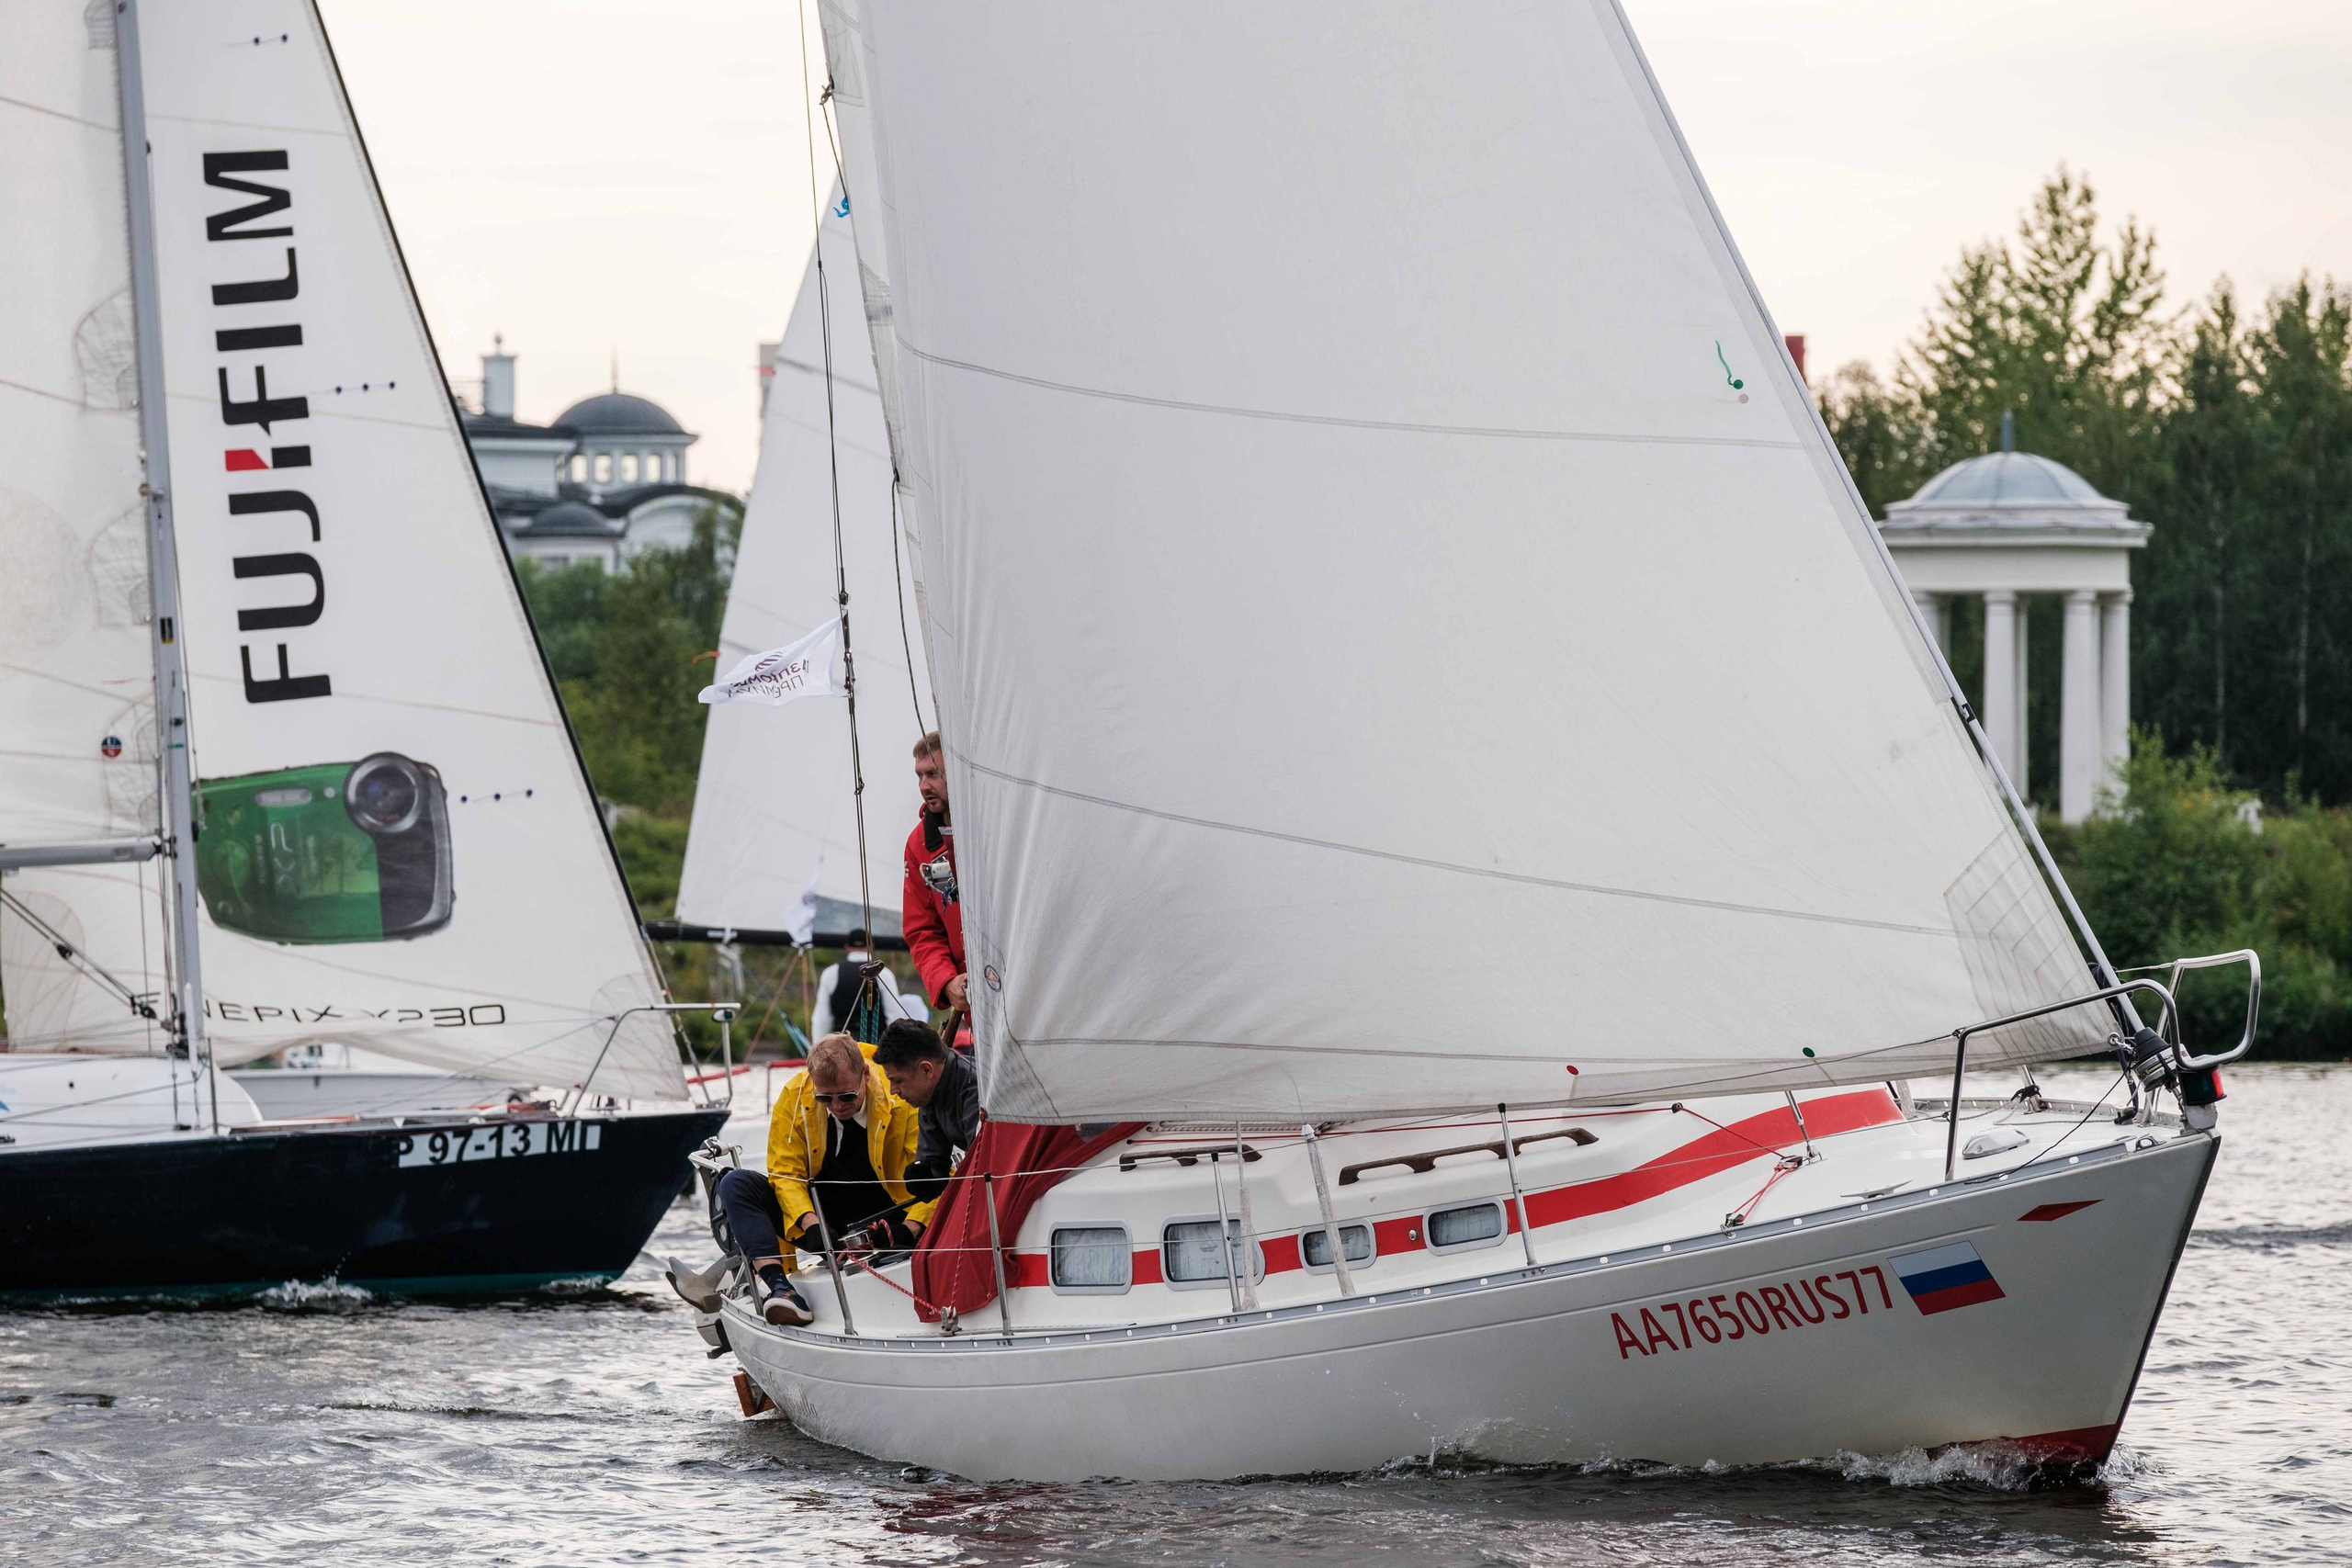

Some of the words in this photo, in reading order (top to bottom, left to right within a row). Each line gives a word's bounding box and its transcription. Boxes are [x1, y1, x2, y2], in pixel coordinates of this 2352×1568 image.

[203, 149, 332, 704] FUJIFILM
[130, 991, 344, 1023] FEPIX
[428, 1122, 531, 1165] 97-13
[1610, 1265, 1894, 1360] AA7650RUS77
